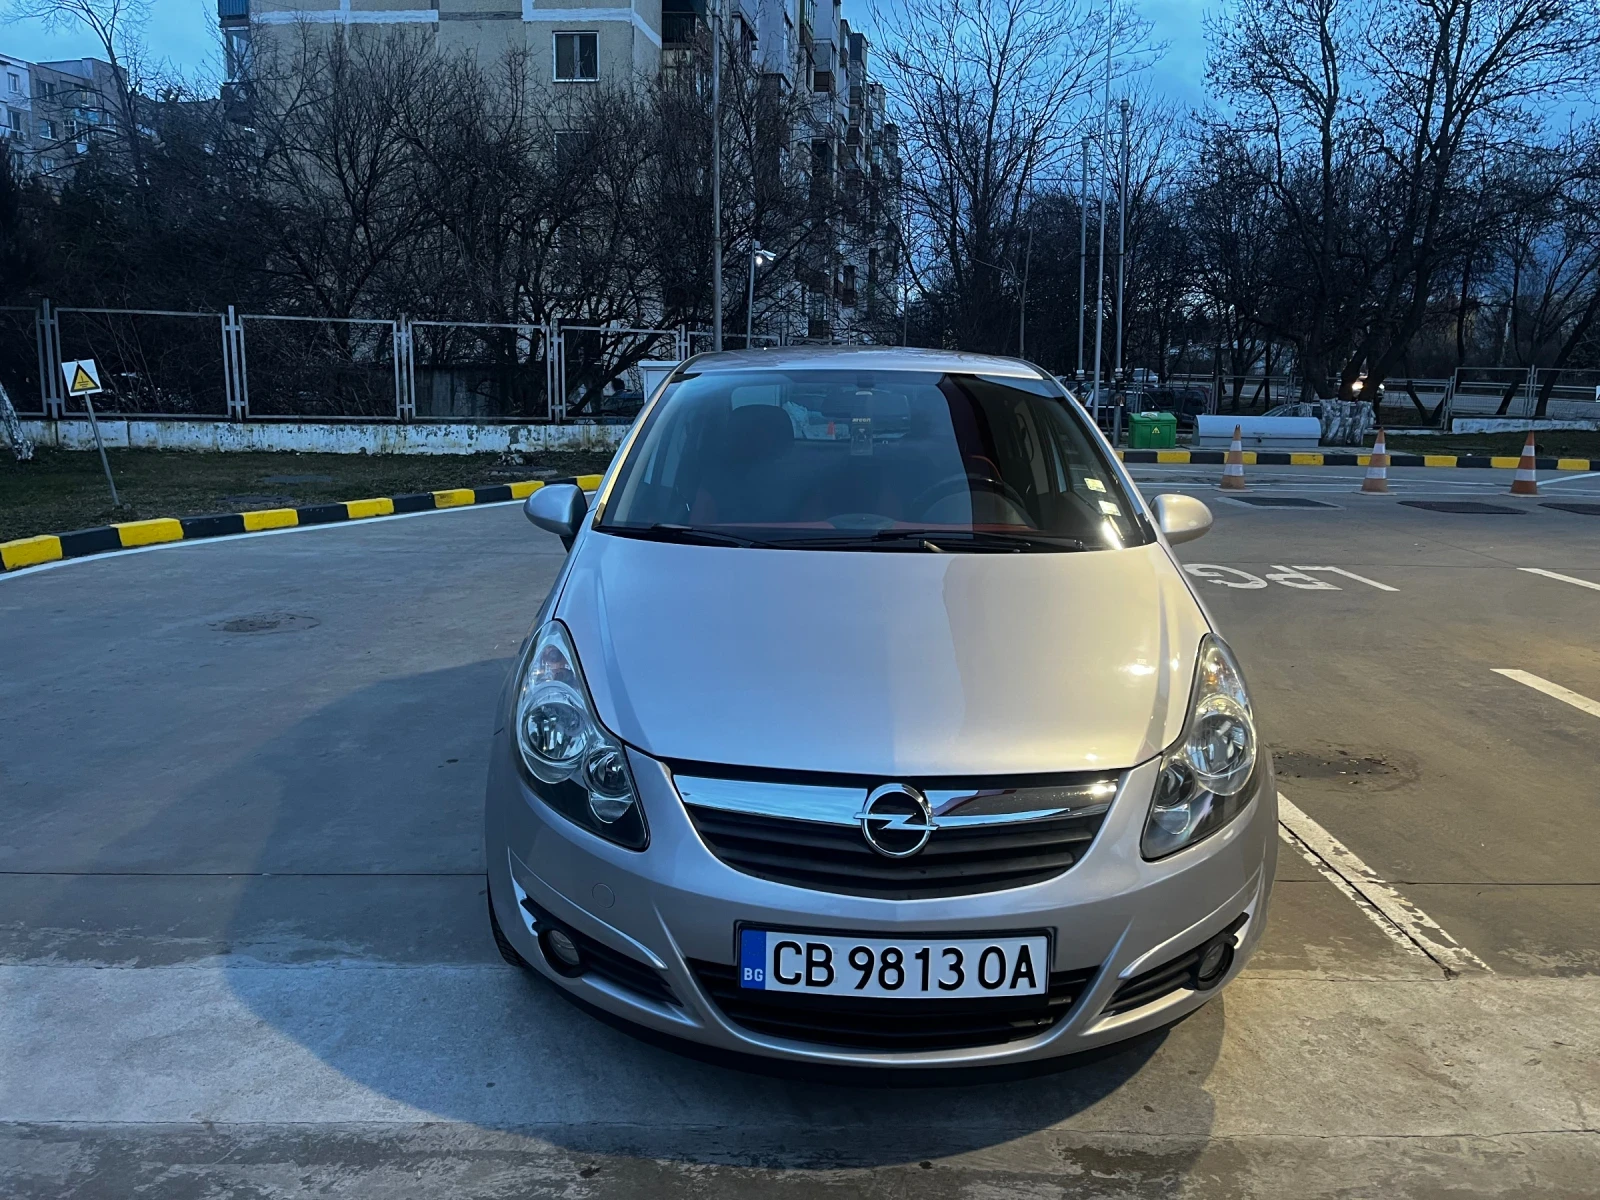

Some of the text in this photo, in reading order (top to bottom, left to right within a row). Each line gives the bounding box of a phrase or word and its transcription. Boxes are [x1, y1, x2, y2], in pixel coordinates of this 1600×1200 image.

[744, 967, 763, 982] BG
[773, 940, 1037, 992] CB 9813 OA
